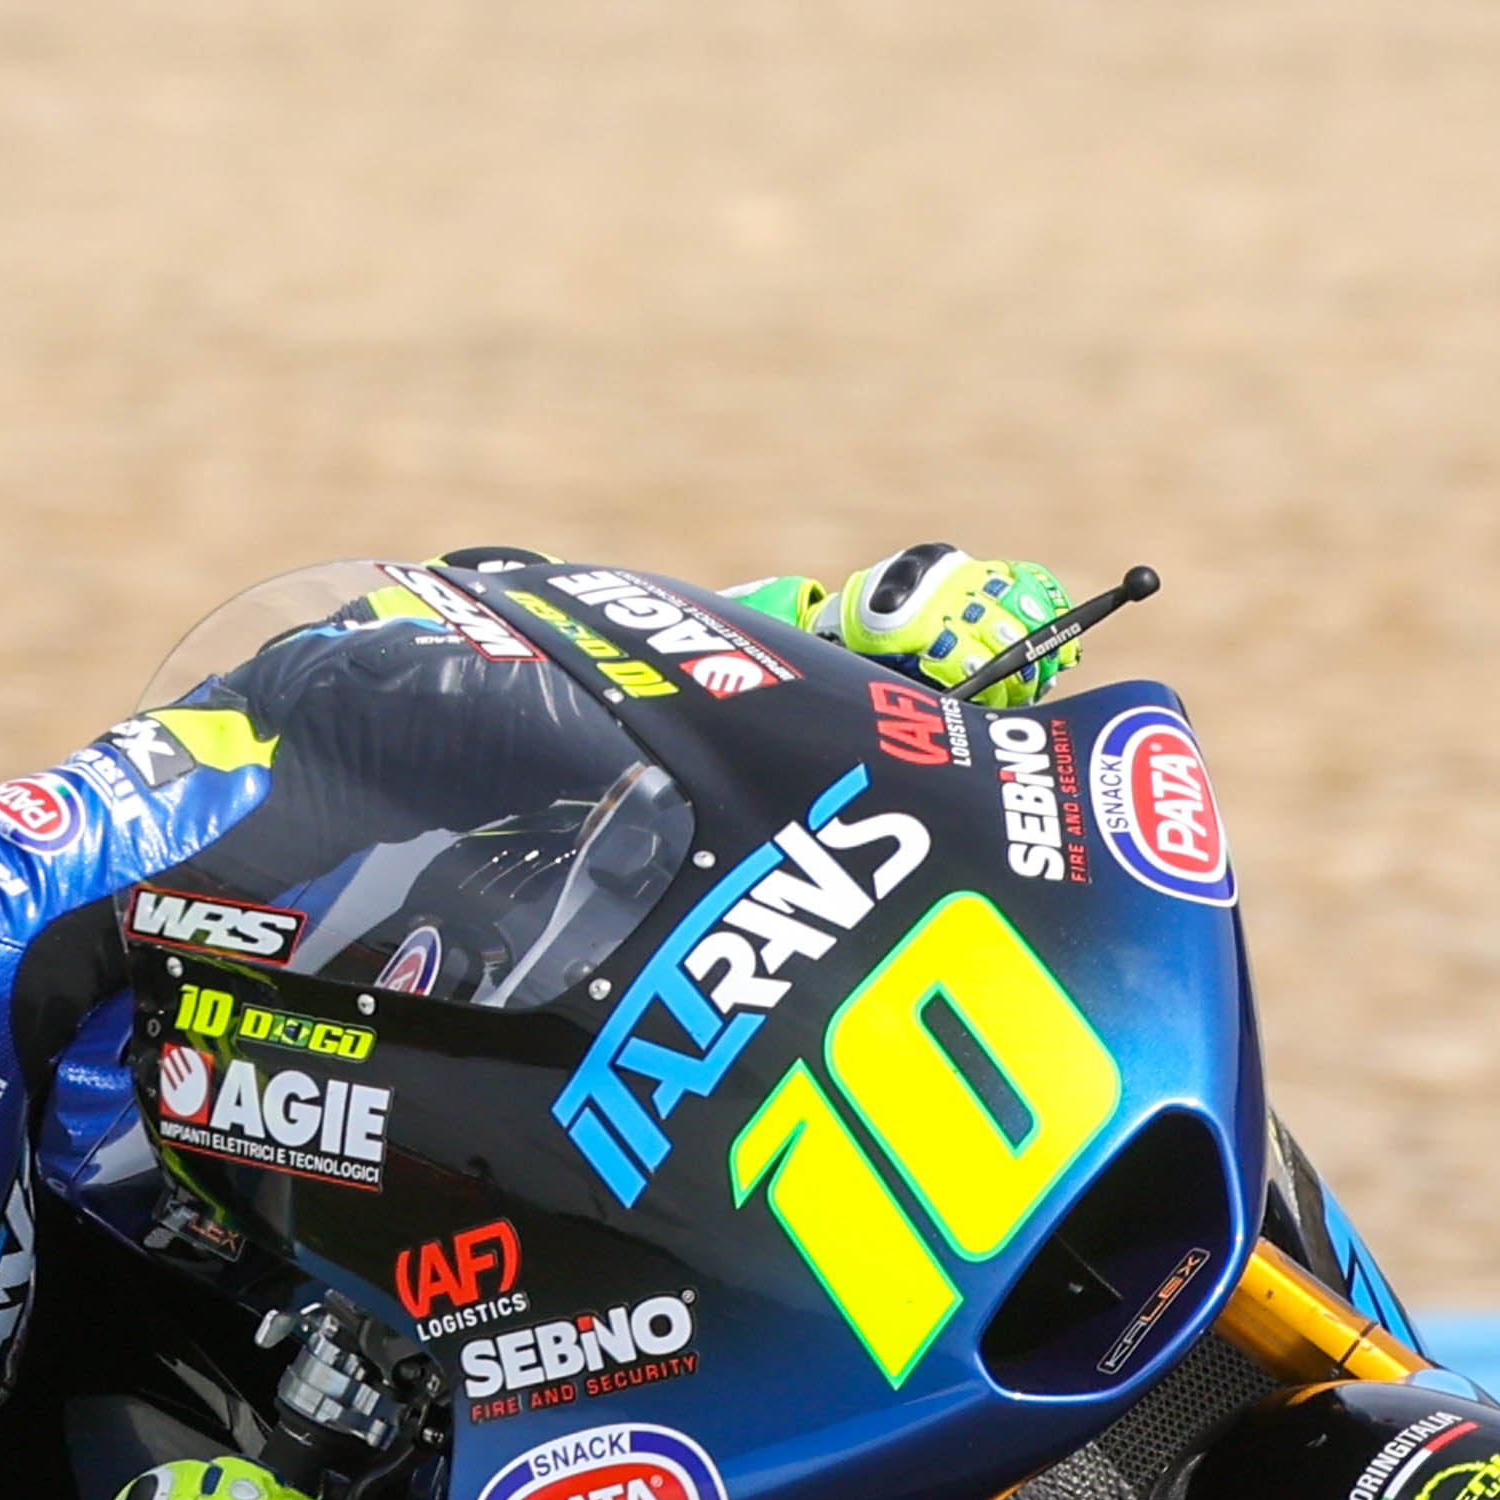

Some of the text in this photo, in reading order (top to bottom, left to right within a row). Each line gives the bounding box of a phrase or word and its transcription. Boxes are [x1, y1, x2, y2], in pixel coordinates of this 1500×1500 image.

[546, 570, 736, 655] AGIE
[1025, 622, 1082, 661] domino
[940, 696, 972, 767] LOGISTICS
[1052, 719, 1090, 884] FIRE AND SECURITY
[1100, 759, 1130, 829] SNACK
[1149, 752, 1210, 862] PATA
[132, 891, 298, 956] WRS
[175, 983, 235, 1038] 10
[208, 1059, 391, 1163] AGIE
[728, 890, 1123, 1390] 10
[159, 1119, 380, 1184] IMPIANTI ELETTRICI E TECNOLOGICI
[416, 1292, 529, 1343] LOGISTICS
[1103, 1254, 1202, 1368] KALEX
[470, 1353, 701, 1424] FIRE AND SECURITY
[533, 1431, 628, 1478] SNACK
